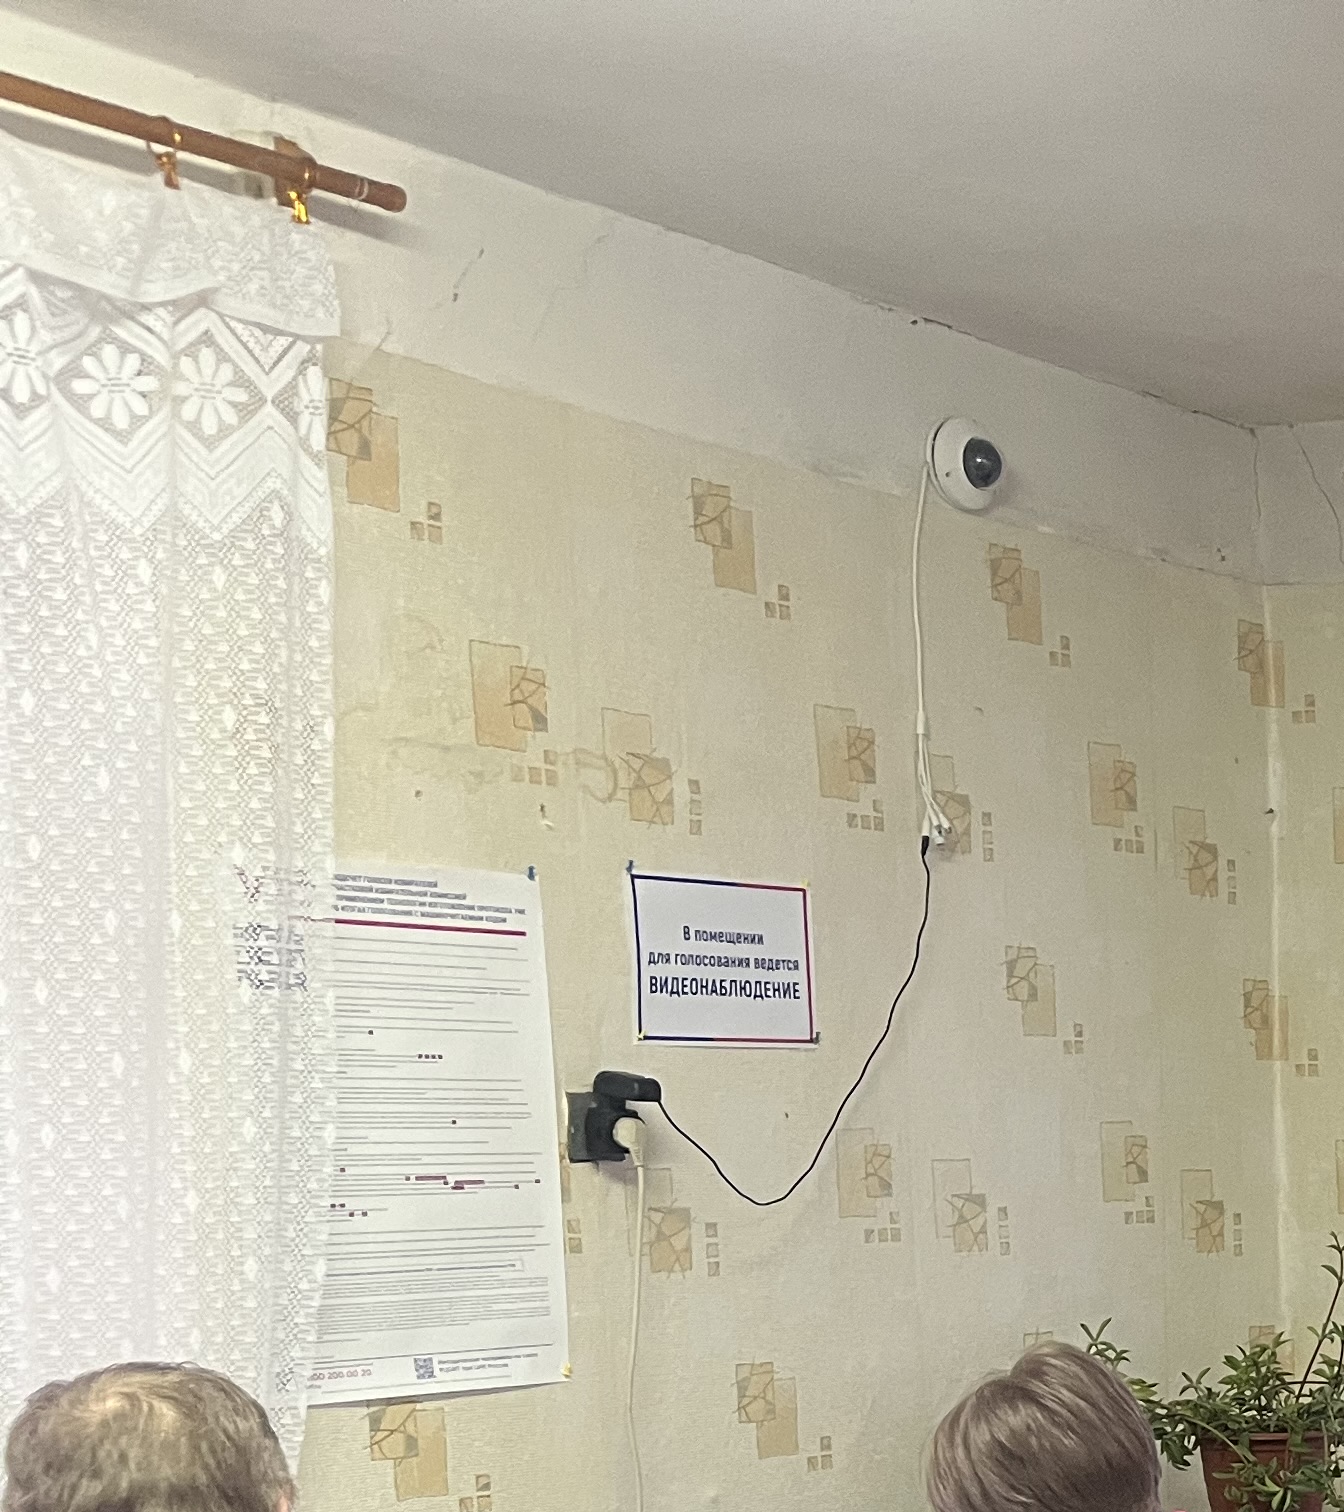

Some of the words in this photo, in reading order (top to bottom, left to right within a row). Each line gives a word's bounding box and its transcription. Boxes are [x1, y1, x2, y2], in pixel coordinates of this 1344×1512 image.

[683, 926, 691, 940] В
[694, 929, 764, 945] помещении
[648, 952, 671, 966] для
[674, 953, 750, 968] голосования
[754, 957, 800, 972] ведется
[649, 975, 801, 1001] ВИДЕОНАБЛЮДЕНИЕ
